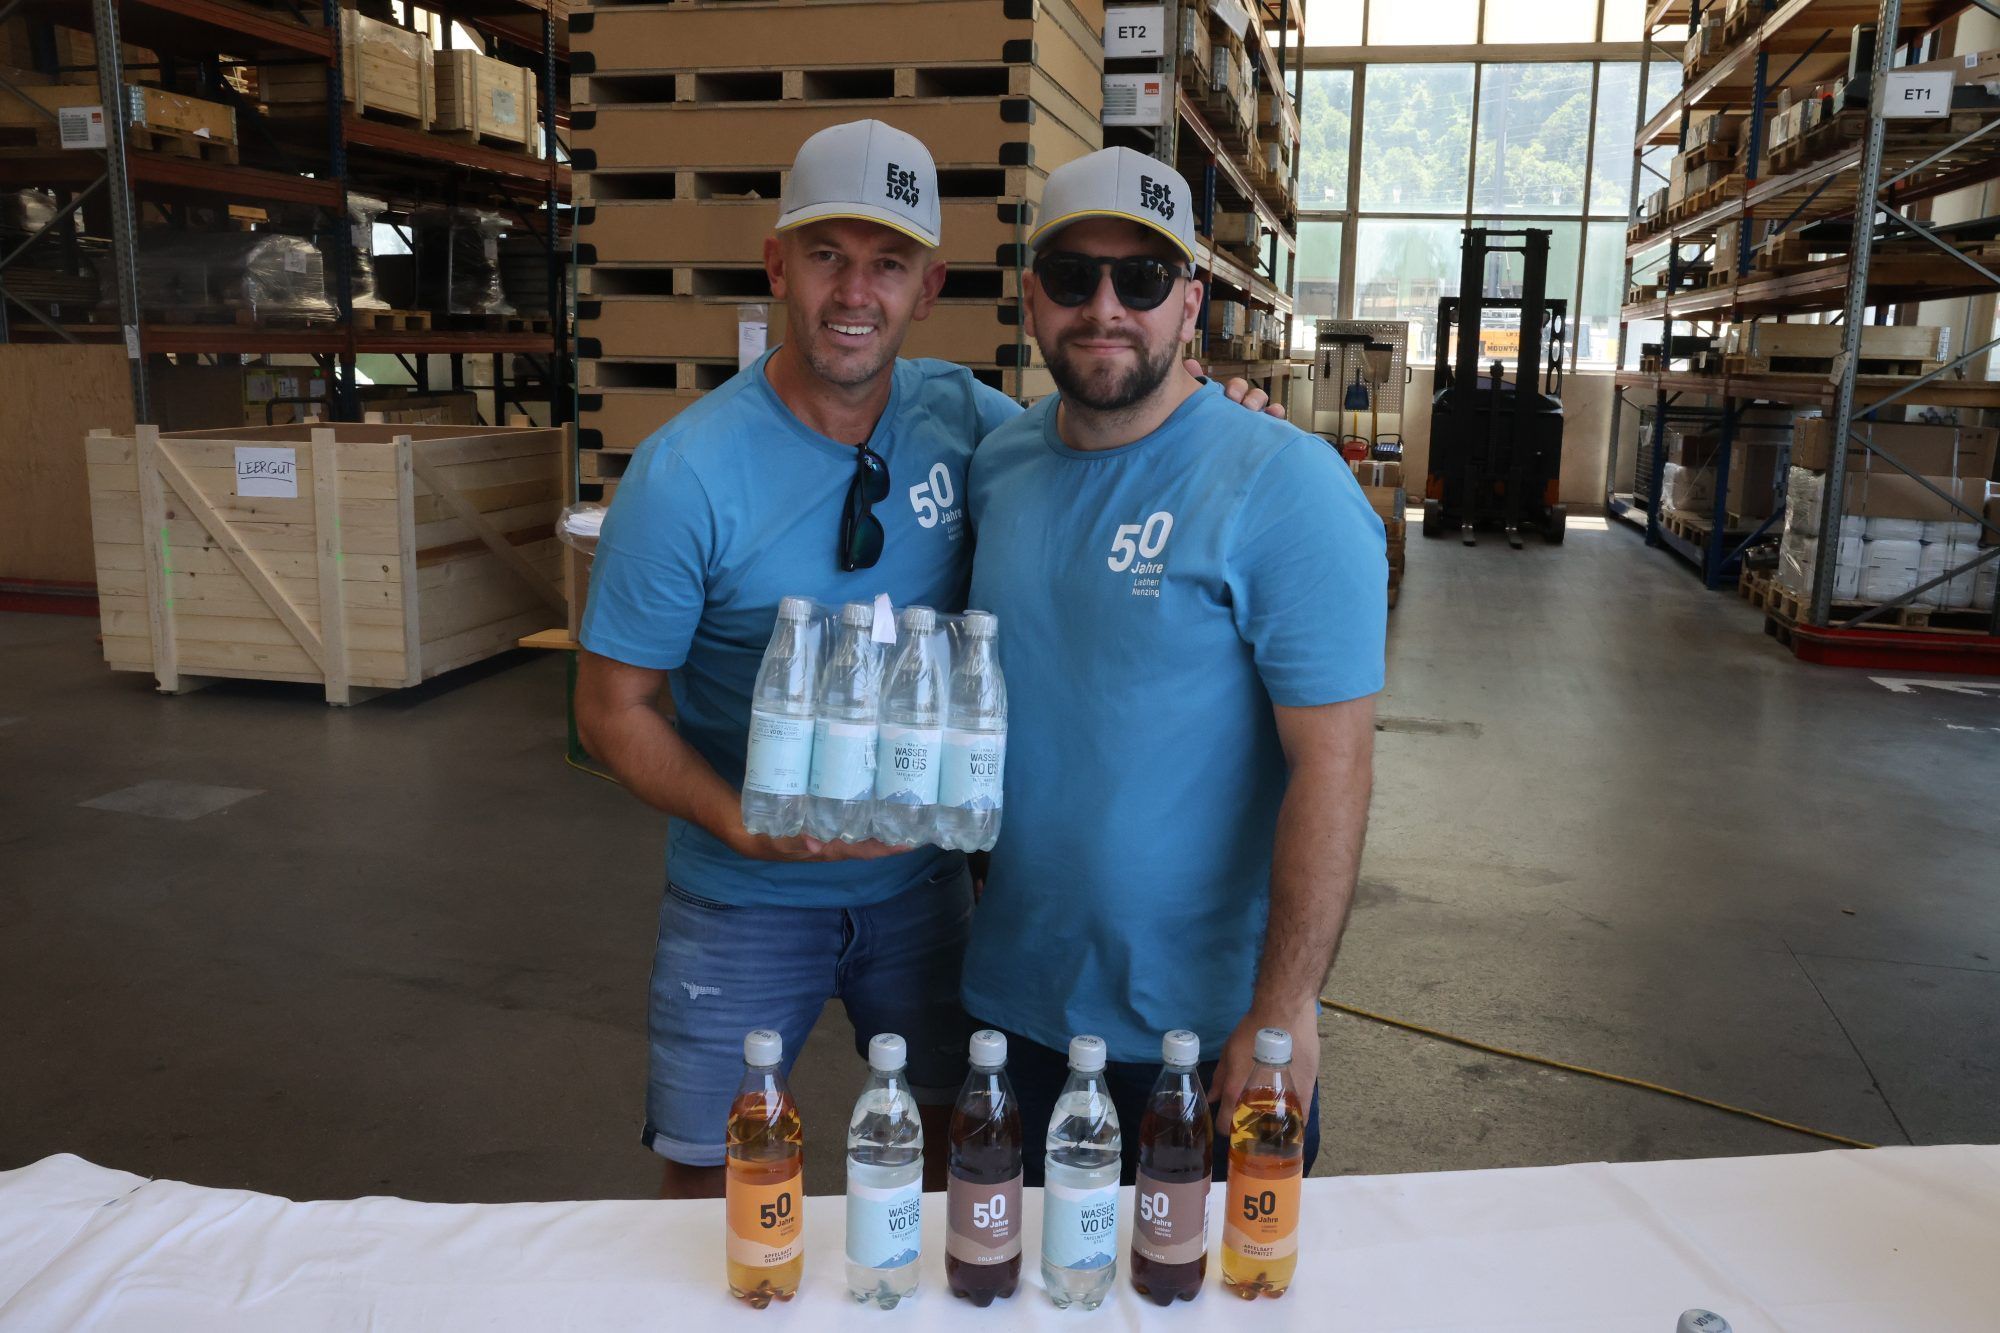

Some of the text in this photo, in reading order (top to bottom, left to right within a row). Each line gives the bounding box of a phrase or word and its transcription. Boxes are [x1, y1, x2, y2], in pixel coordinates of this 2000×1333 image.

[1118, 25, 1147, 39] ET2
[1904, 88, 1931, 100] ET1
[887, 162, 920, 195] Est.
[886, 182, 919, 208] 1949
[1140, 192, 1175, 221] 1949
[238, 460, 296, 475] LEERGUT
[909, 462, 954, 529] 50
[940, 508, 963, 525] Jahre
[1107, 511, 1174, 573] 50
[1131, 561, 1164, 574] Jahre
[1133, 578, 1160, 587] Liebherr
[1131, 587, 1160, 598] Nenzing
[895, 747, 928, 758] WASSER
[894, 757, 909, 770] VO
[970, 762, 985, 775] VO
[760, 1192, 792, 1229] 50
[973, 1193, 1006, 1229] 50
[1081, 1203, 1115, 1219] WASSER
[1140, 1192, 1169, 1221] 50
[1243, 1190, 1276, 1221] 50
[888, 1216, 906, 1232] VO
[989, 1219, 1009, 1229] Jahre
[1081, 1219, 1099, 1233] VO
[1152, 1217, 1172, 1228] Jahre
